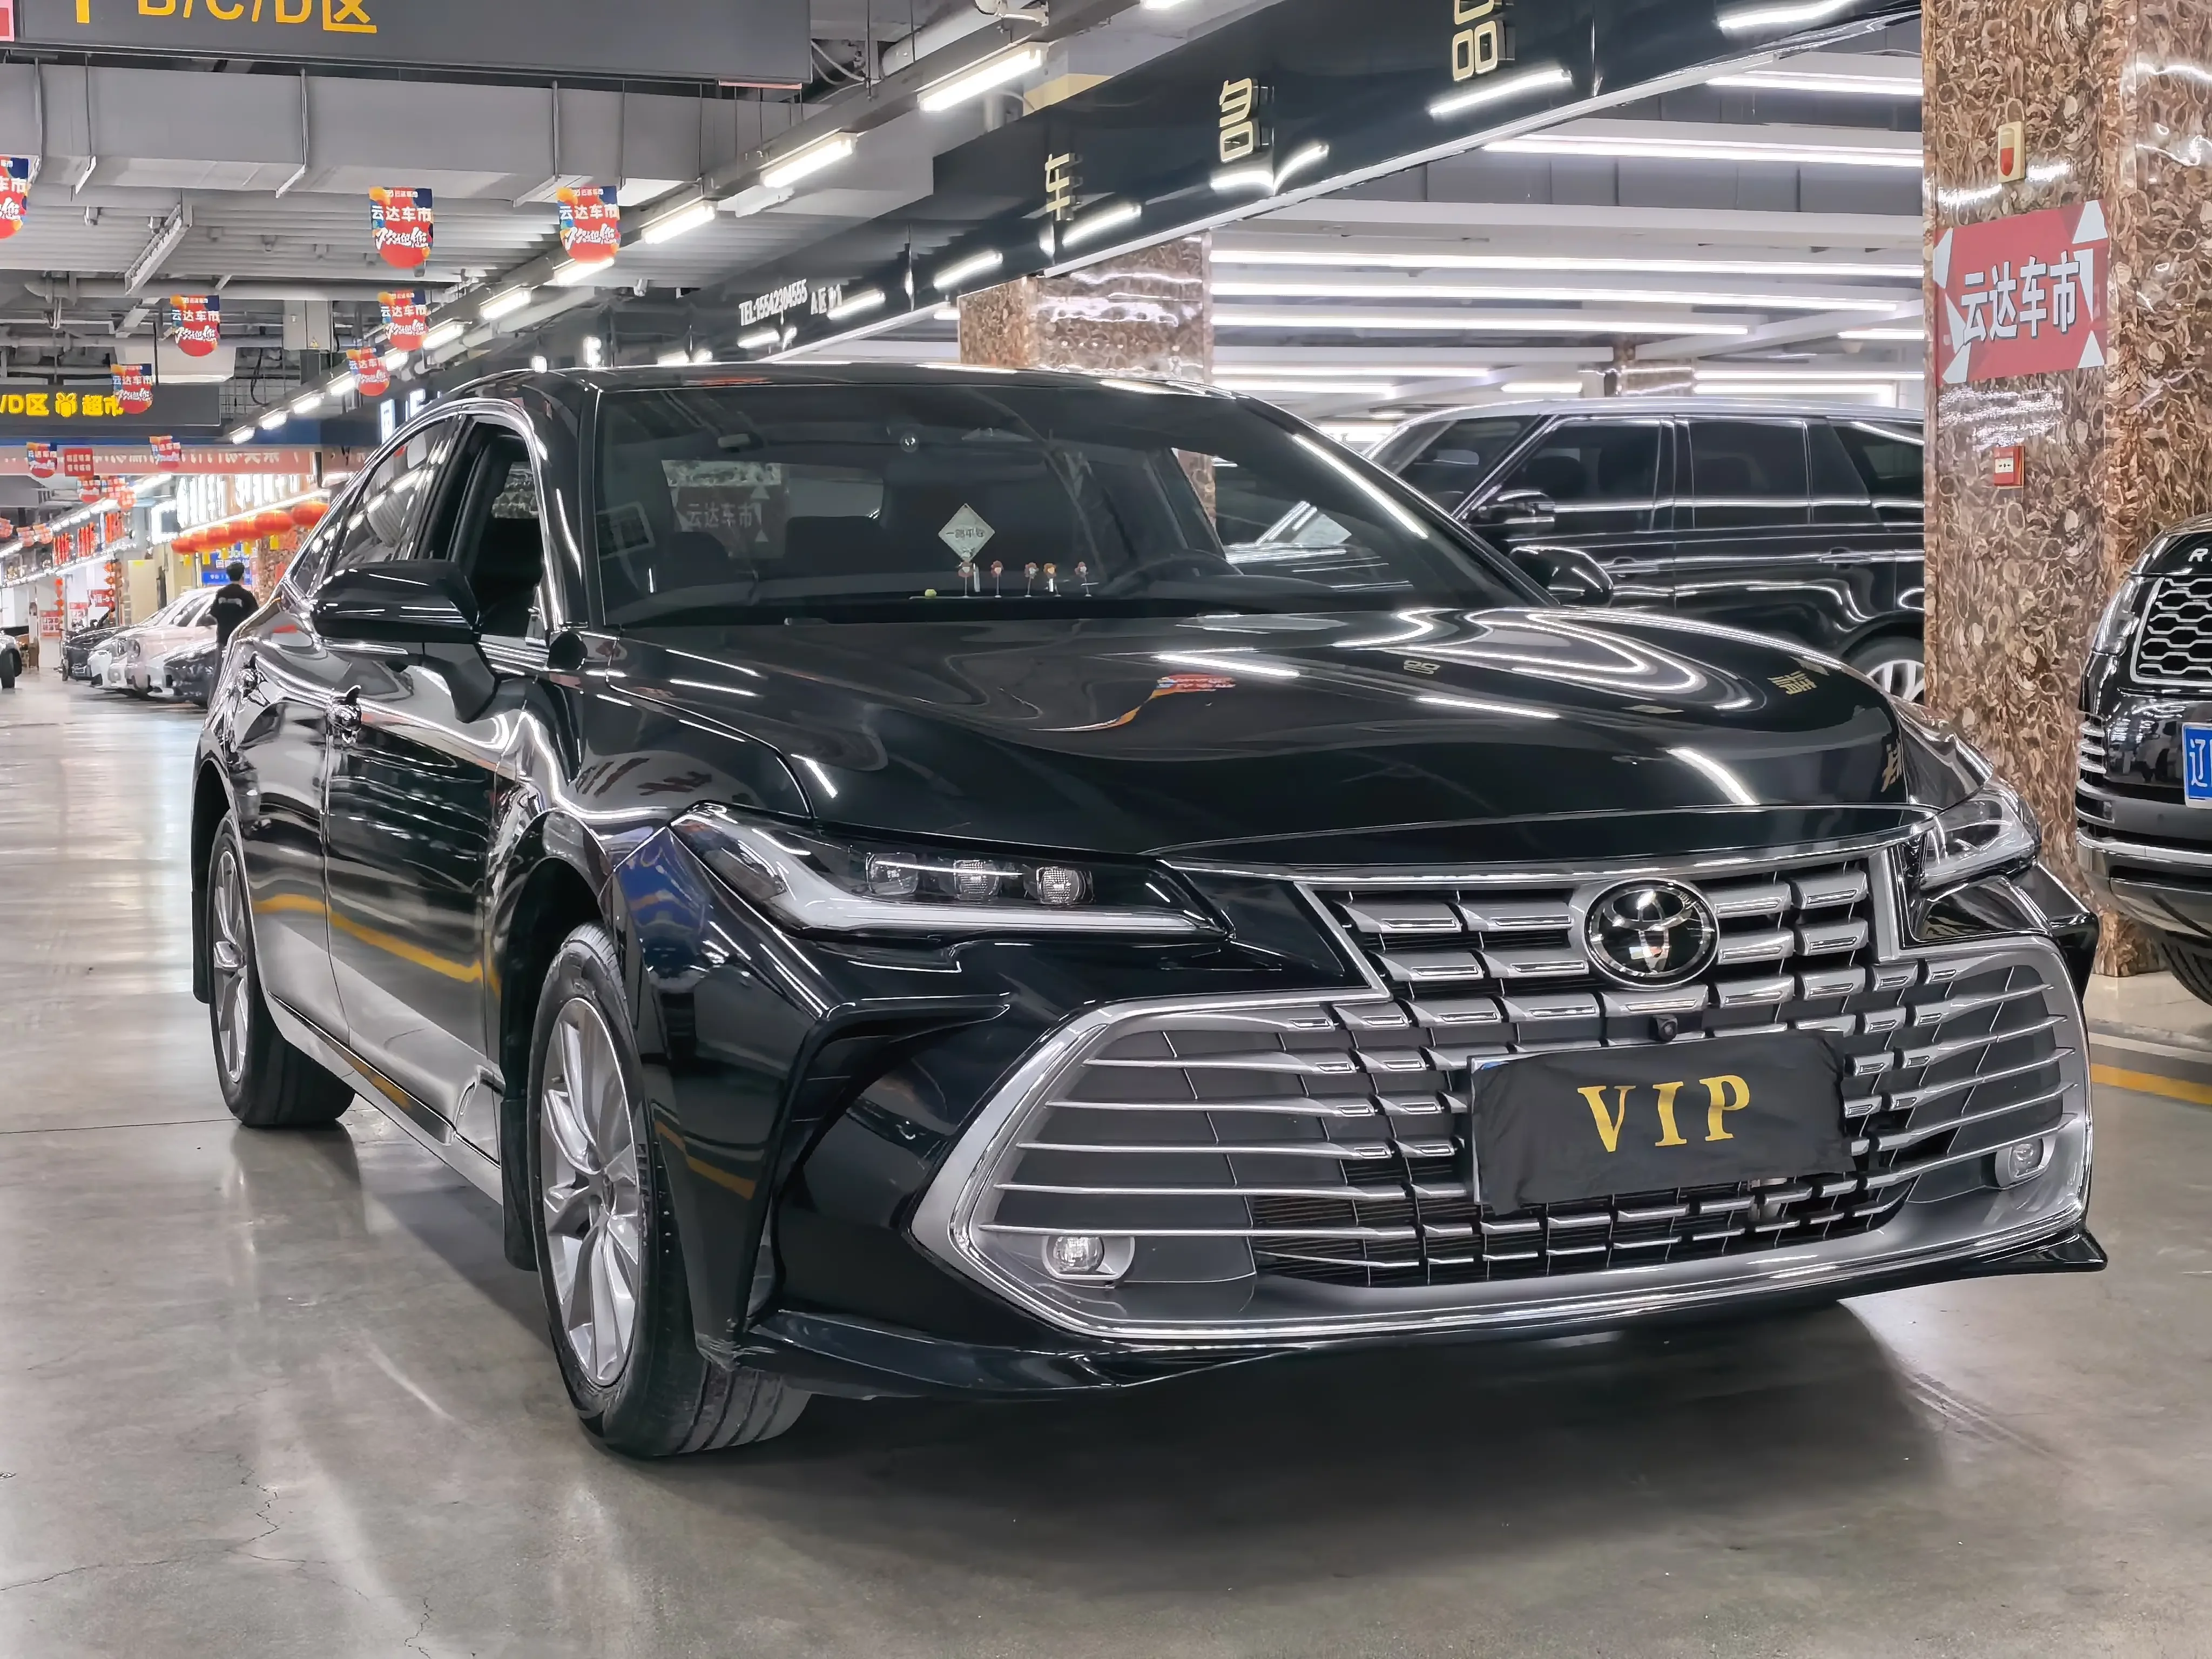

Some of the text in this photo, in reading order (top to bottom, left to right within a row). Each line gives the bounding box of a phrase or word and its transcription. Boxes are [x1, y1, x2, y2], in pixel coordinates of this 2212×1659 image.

[1045, 153, 1070, 221] 车
[372, 205, 432, 222] 云达车市
[559, 204, 619, 220] 云达车市
[375, 227, 429, 251] 欢迎您
[564, 223, 617, 251] 欢迎您
[380, 304, 427, 318] 云达车市
[1960, 251, 2080, 347] 云达车市
[171, 309, 220, 322] 云达车市
[686, 501, 752, 529] 云达车市
[2188, 548, 2212, 562] R
[2189, 738, 2212, 787] 辽
[1577, 1075, 1751, 1153] VIP
